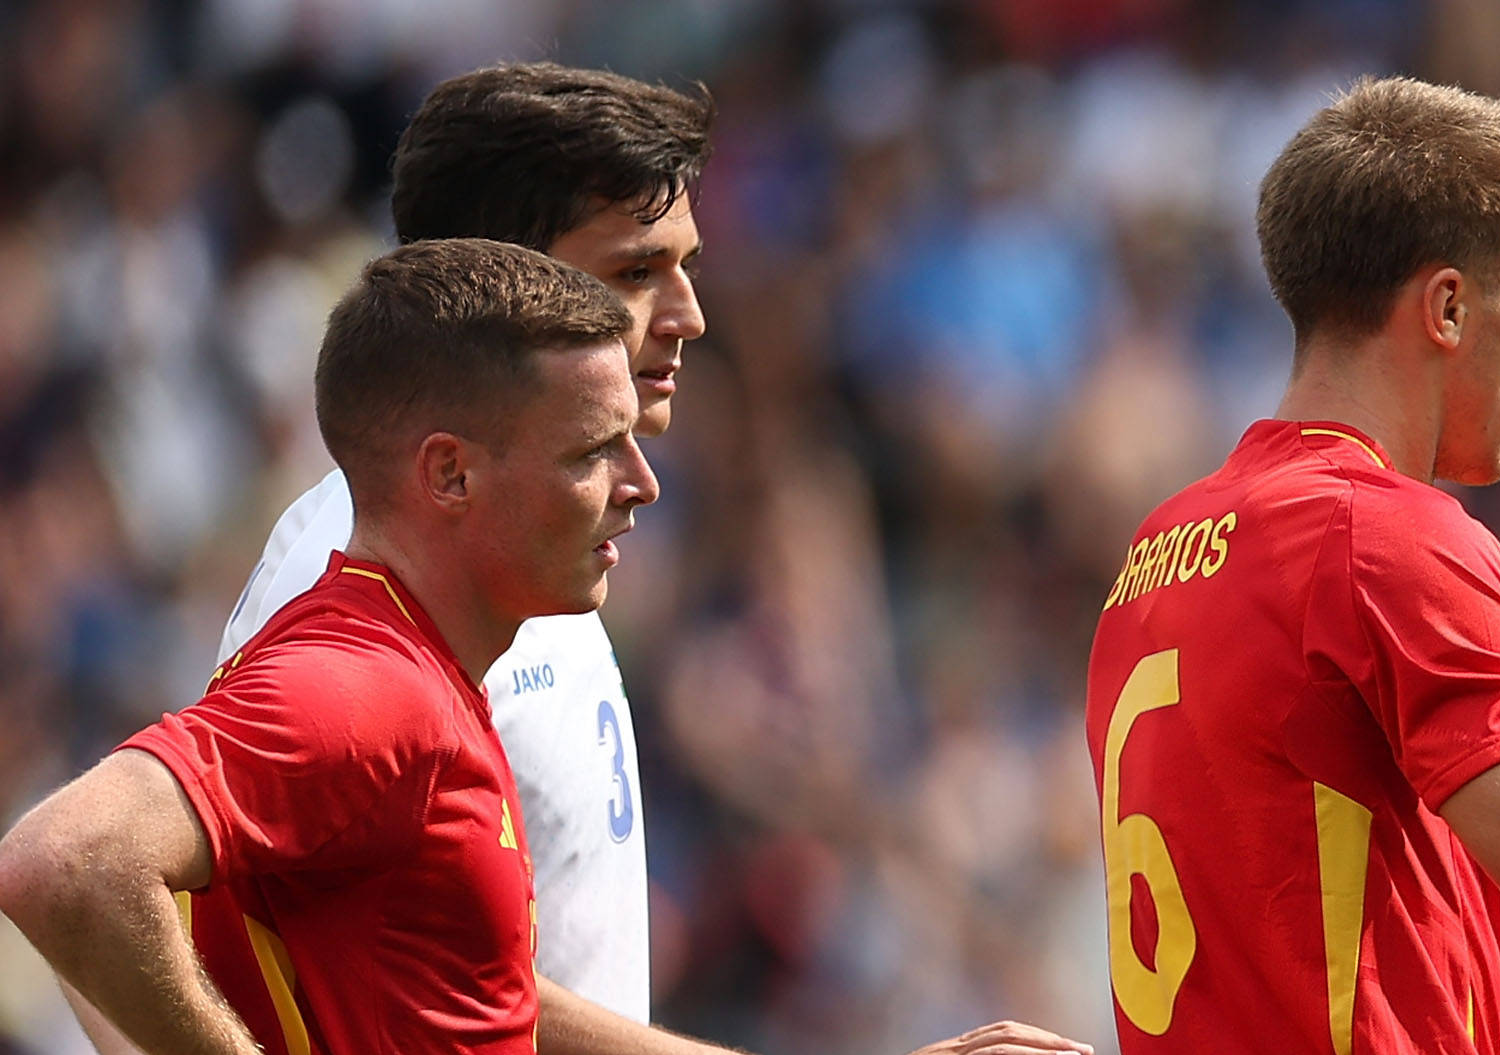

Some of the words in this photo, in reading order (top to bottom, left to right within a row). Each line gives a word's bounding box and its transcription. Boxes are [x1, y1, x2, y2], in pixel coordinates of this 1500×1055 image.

[513, 664, 554, 695] JAKO
[597, 700, 633, 844] 3
[1102, 648, 1197, 1036] 6
